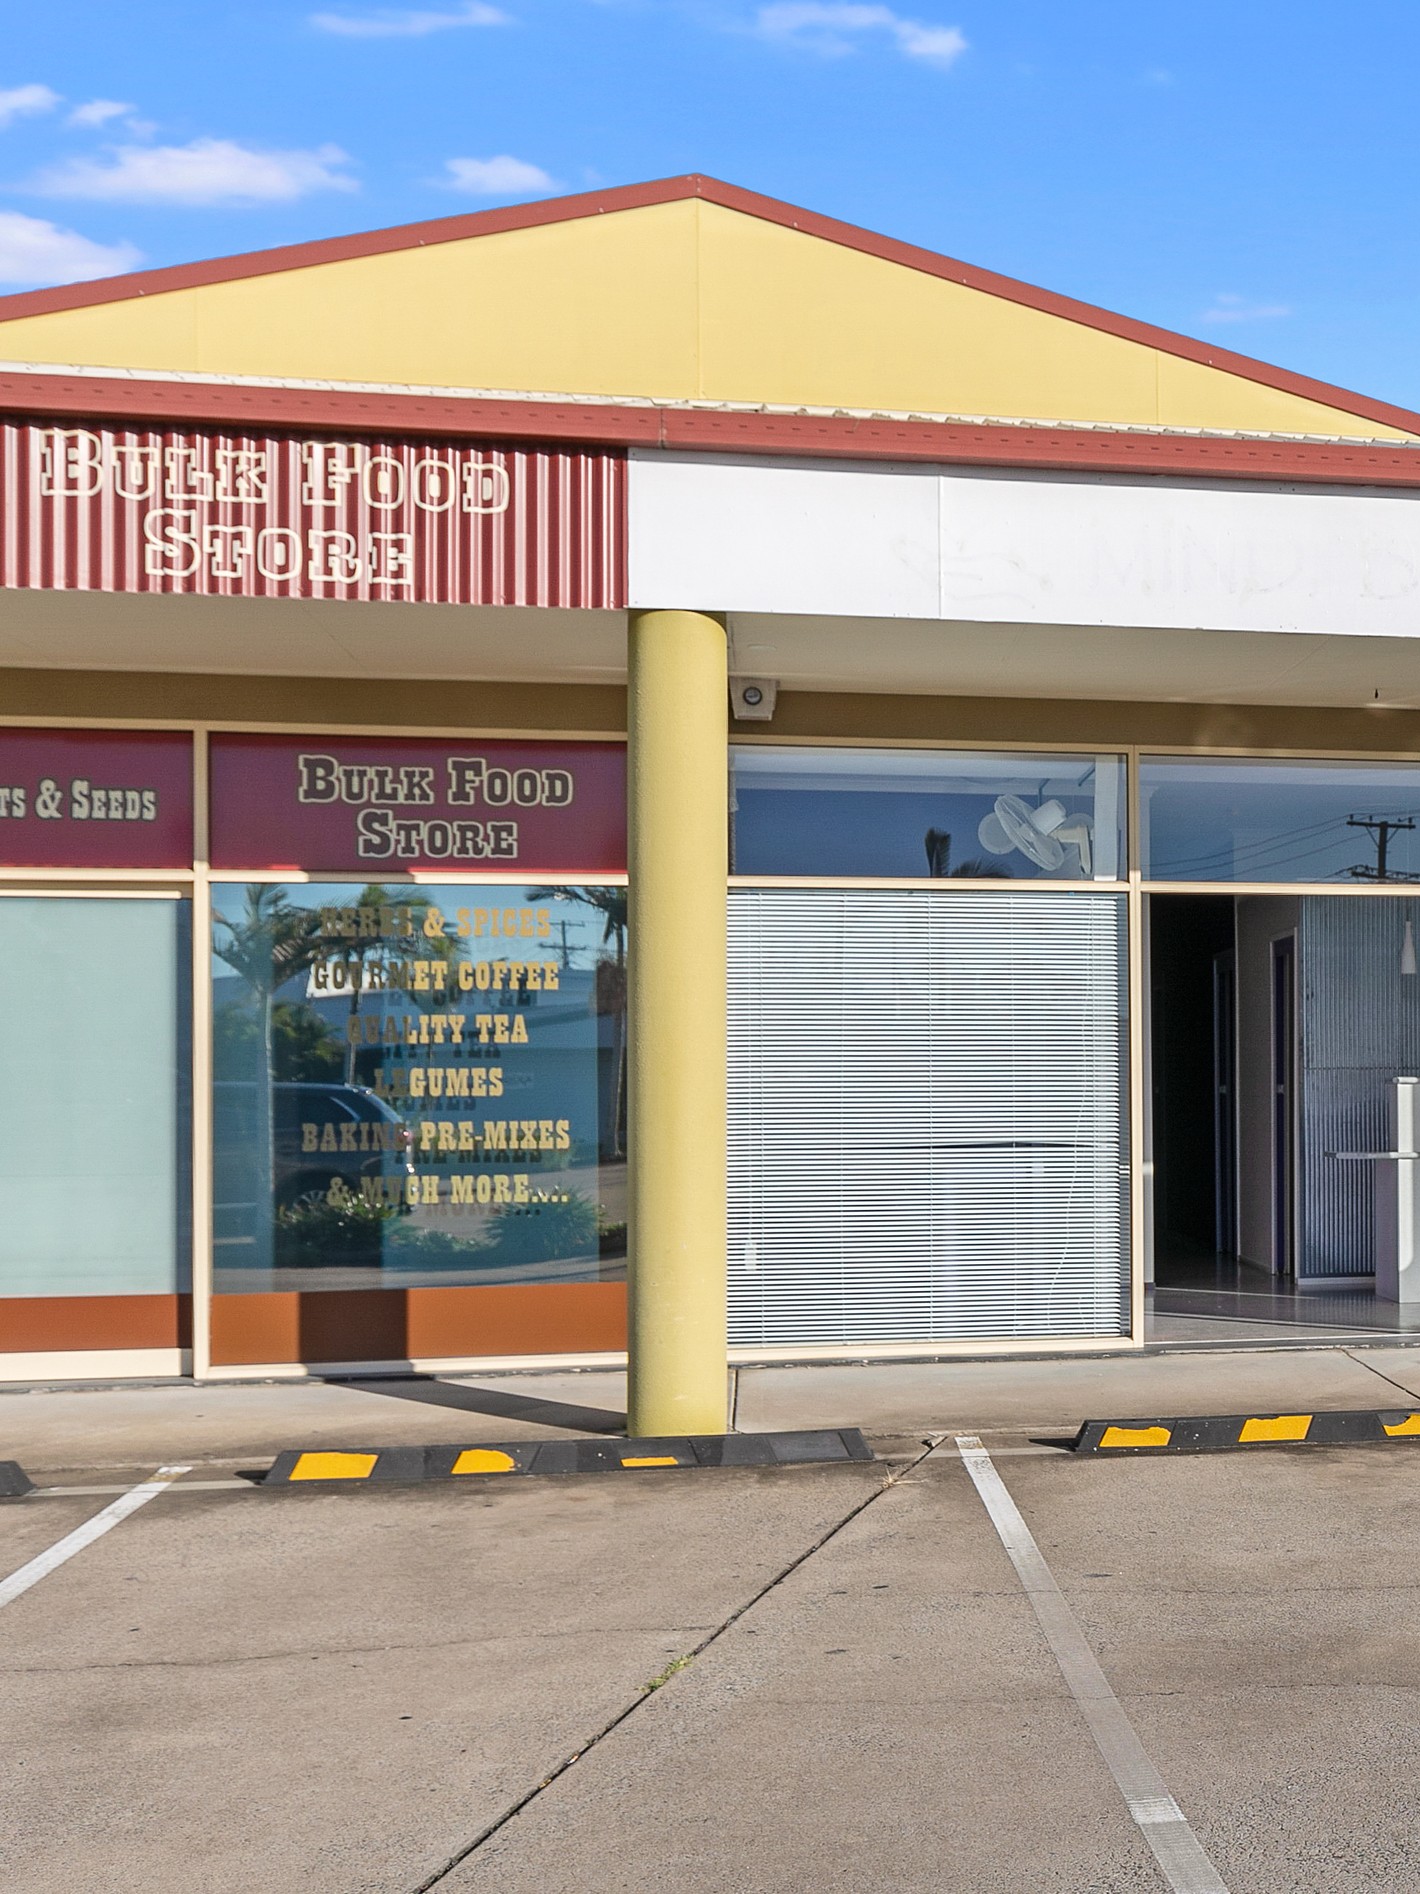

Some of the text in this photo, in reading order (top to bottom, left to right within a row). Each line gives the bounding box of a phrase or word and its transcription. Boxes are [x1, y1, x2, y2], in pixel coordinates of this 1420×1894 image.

[40, 429, 511, 514] BULK FOOD
[144, 508, 415, 585] STORE
[299, 755, 574, 807] BULK FOOD
[35, 778, 63, 819] &
[71, 779, 157, 821] SEEDS
[357, 810, 518, 860] STORE
[423, 906, 447, 938] &
[456, 908, 551, 938] SPICES
[314, 960, 560, 991] GOURMET COFFEE
[347, 1013, 529, 1044] QUALITY TEA
[373, 1067, 504, 1098] LEGUMES
[420, 1119, 571, 1150] PRE-MIXES
[327, 1177, 350, 1207] &
[360, 1175, 440, 1205] MUCH
